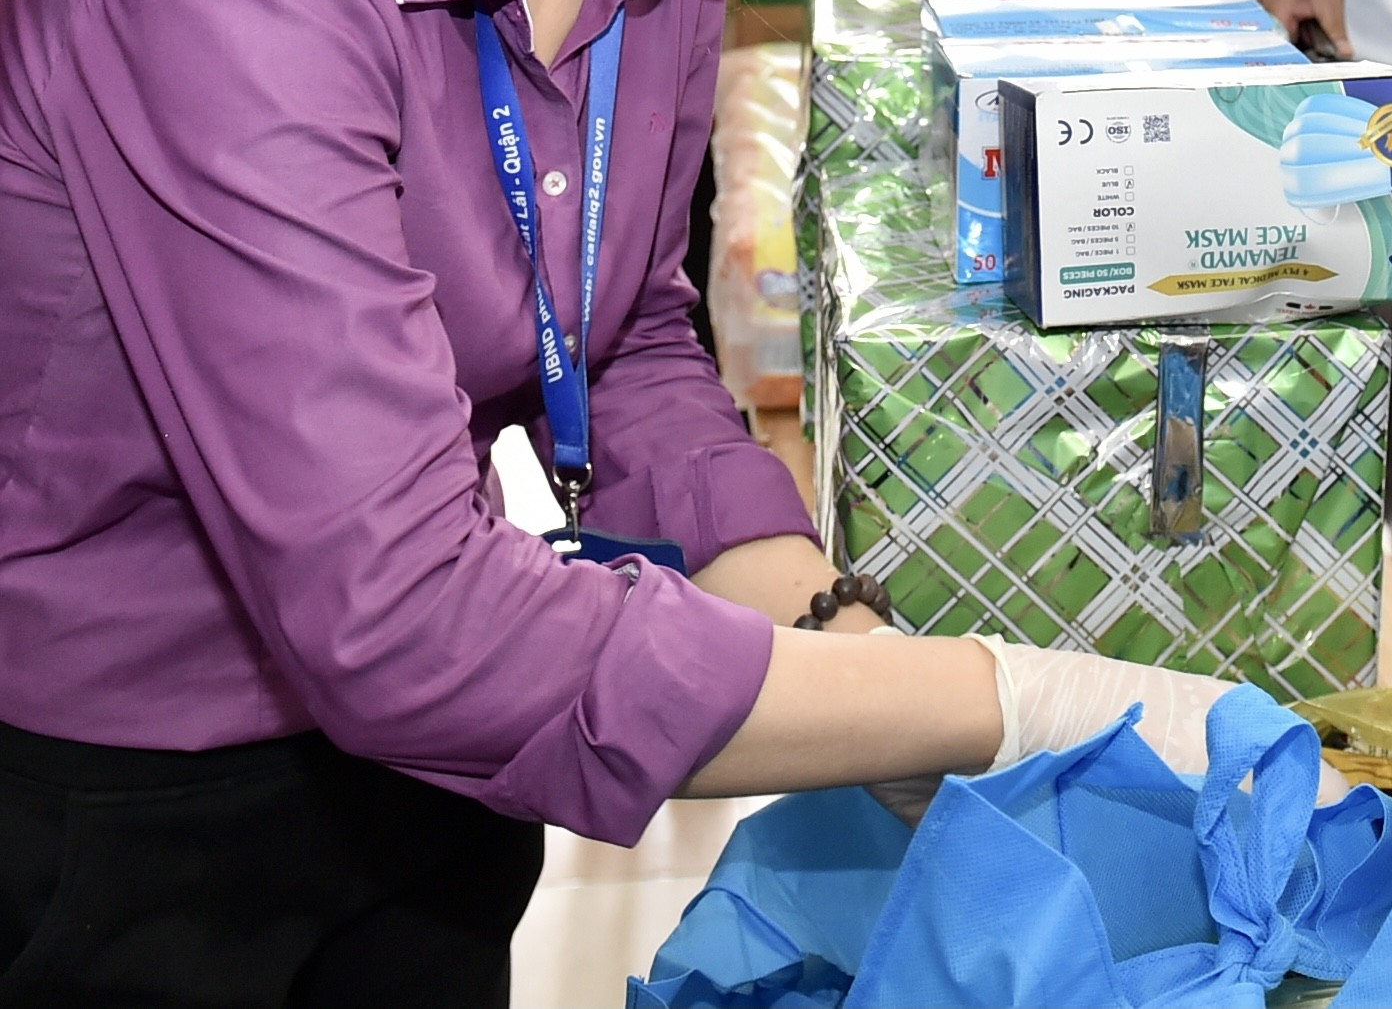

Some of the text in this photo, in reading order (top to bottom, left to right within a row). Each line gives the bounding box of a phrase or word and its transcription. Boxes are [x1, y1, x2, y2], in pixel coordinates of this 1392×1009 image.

[492, 105, 511, 120] 2
[1107, 125, 1129, 135] ISO
[498, 122, 522, 174] Quận
[1096, 167, 1119, 175] BLACK
[1101, 180, 1119, 188] BLUE
[586, 117, 606, 266] catlaiq2.gov.vn
[1093, 206, 1135, 218] COLOR
[1184, 224, 1308, 249] FACE MASK
[973, 254, 997, 271] 50
[1062, 270, 1095, 280] PIECES
[1239, 268, 1280, 286] MEDICAL
[1282, 267, 1301, 276] PLY
[1177, 279, 1208, 290] MASK
[1210, 277, 1235, 288] FACE
[1063, 283, 1135, 299] PACKAGING
[541, 326, 563, 383] UBND
